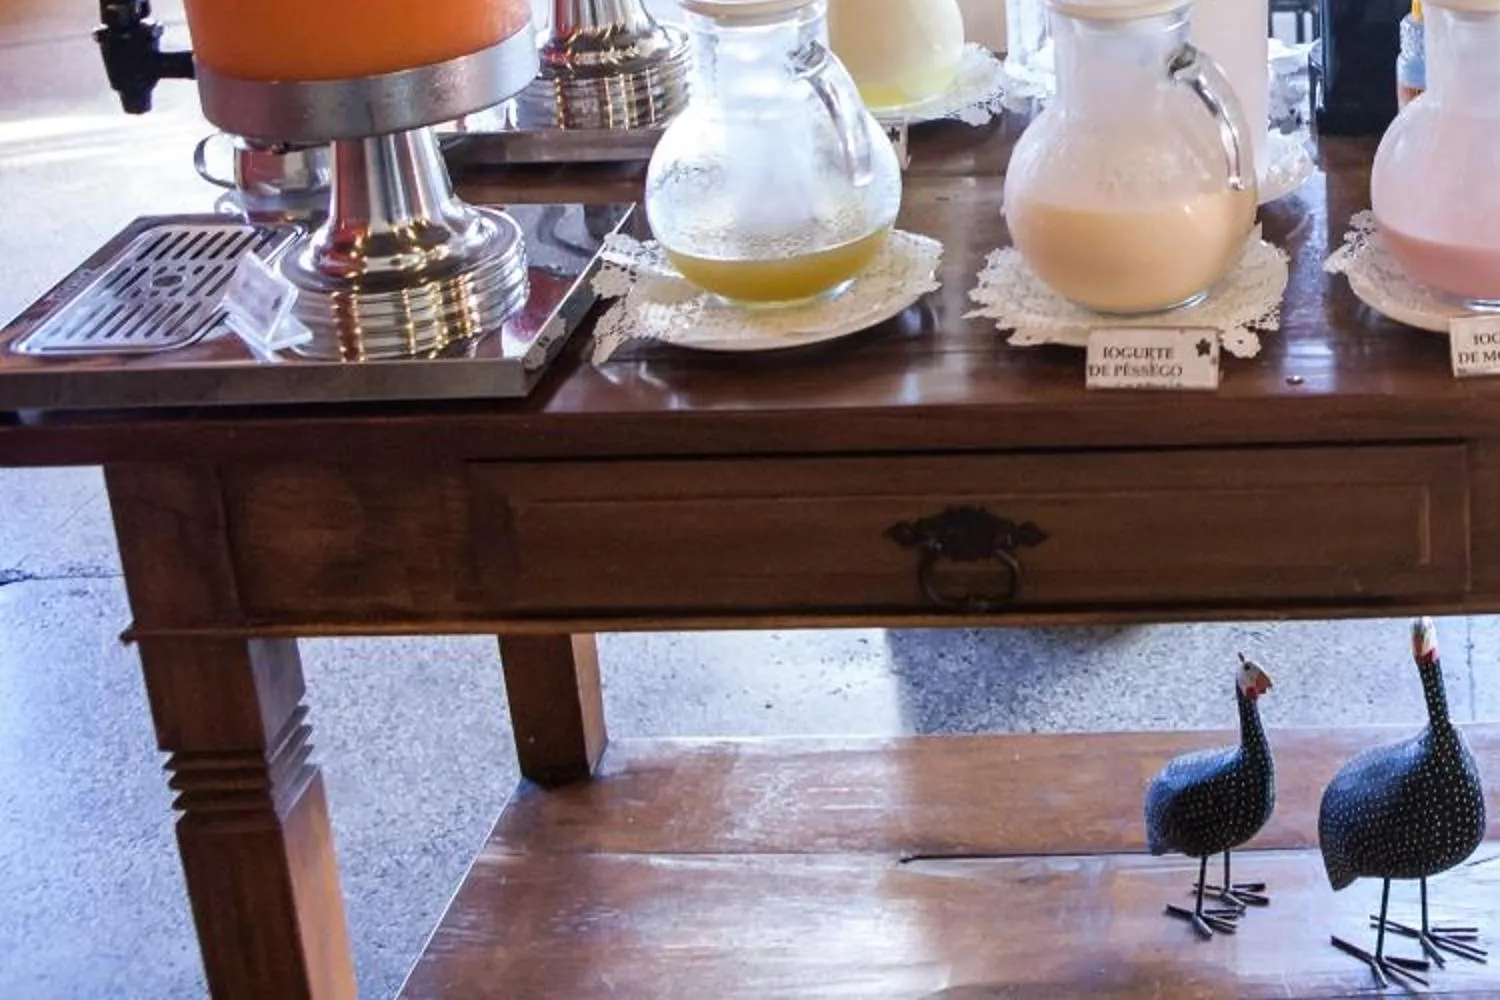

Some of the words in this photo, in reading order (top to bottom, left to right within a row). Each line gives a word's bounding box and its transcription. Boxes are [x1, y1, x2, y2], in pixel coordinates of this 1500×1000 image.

[1103, 346, 1174, 360] IOGURTE
[1458, 350, 1478, 364] DE
[1088, 364, 1109, 377] DE
